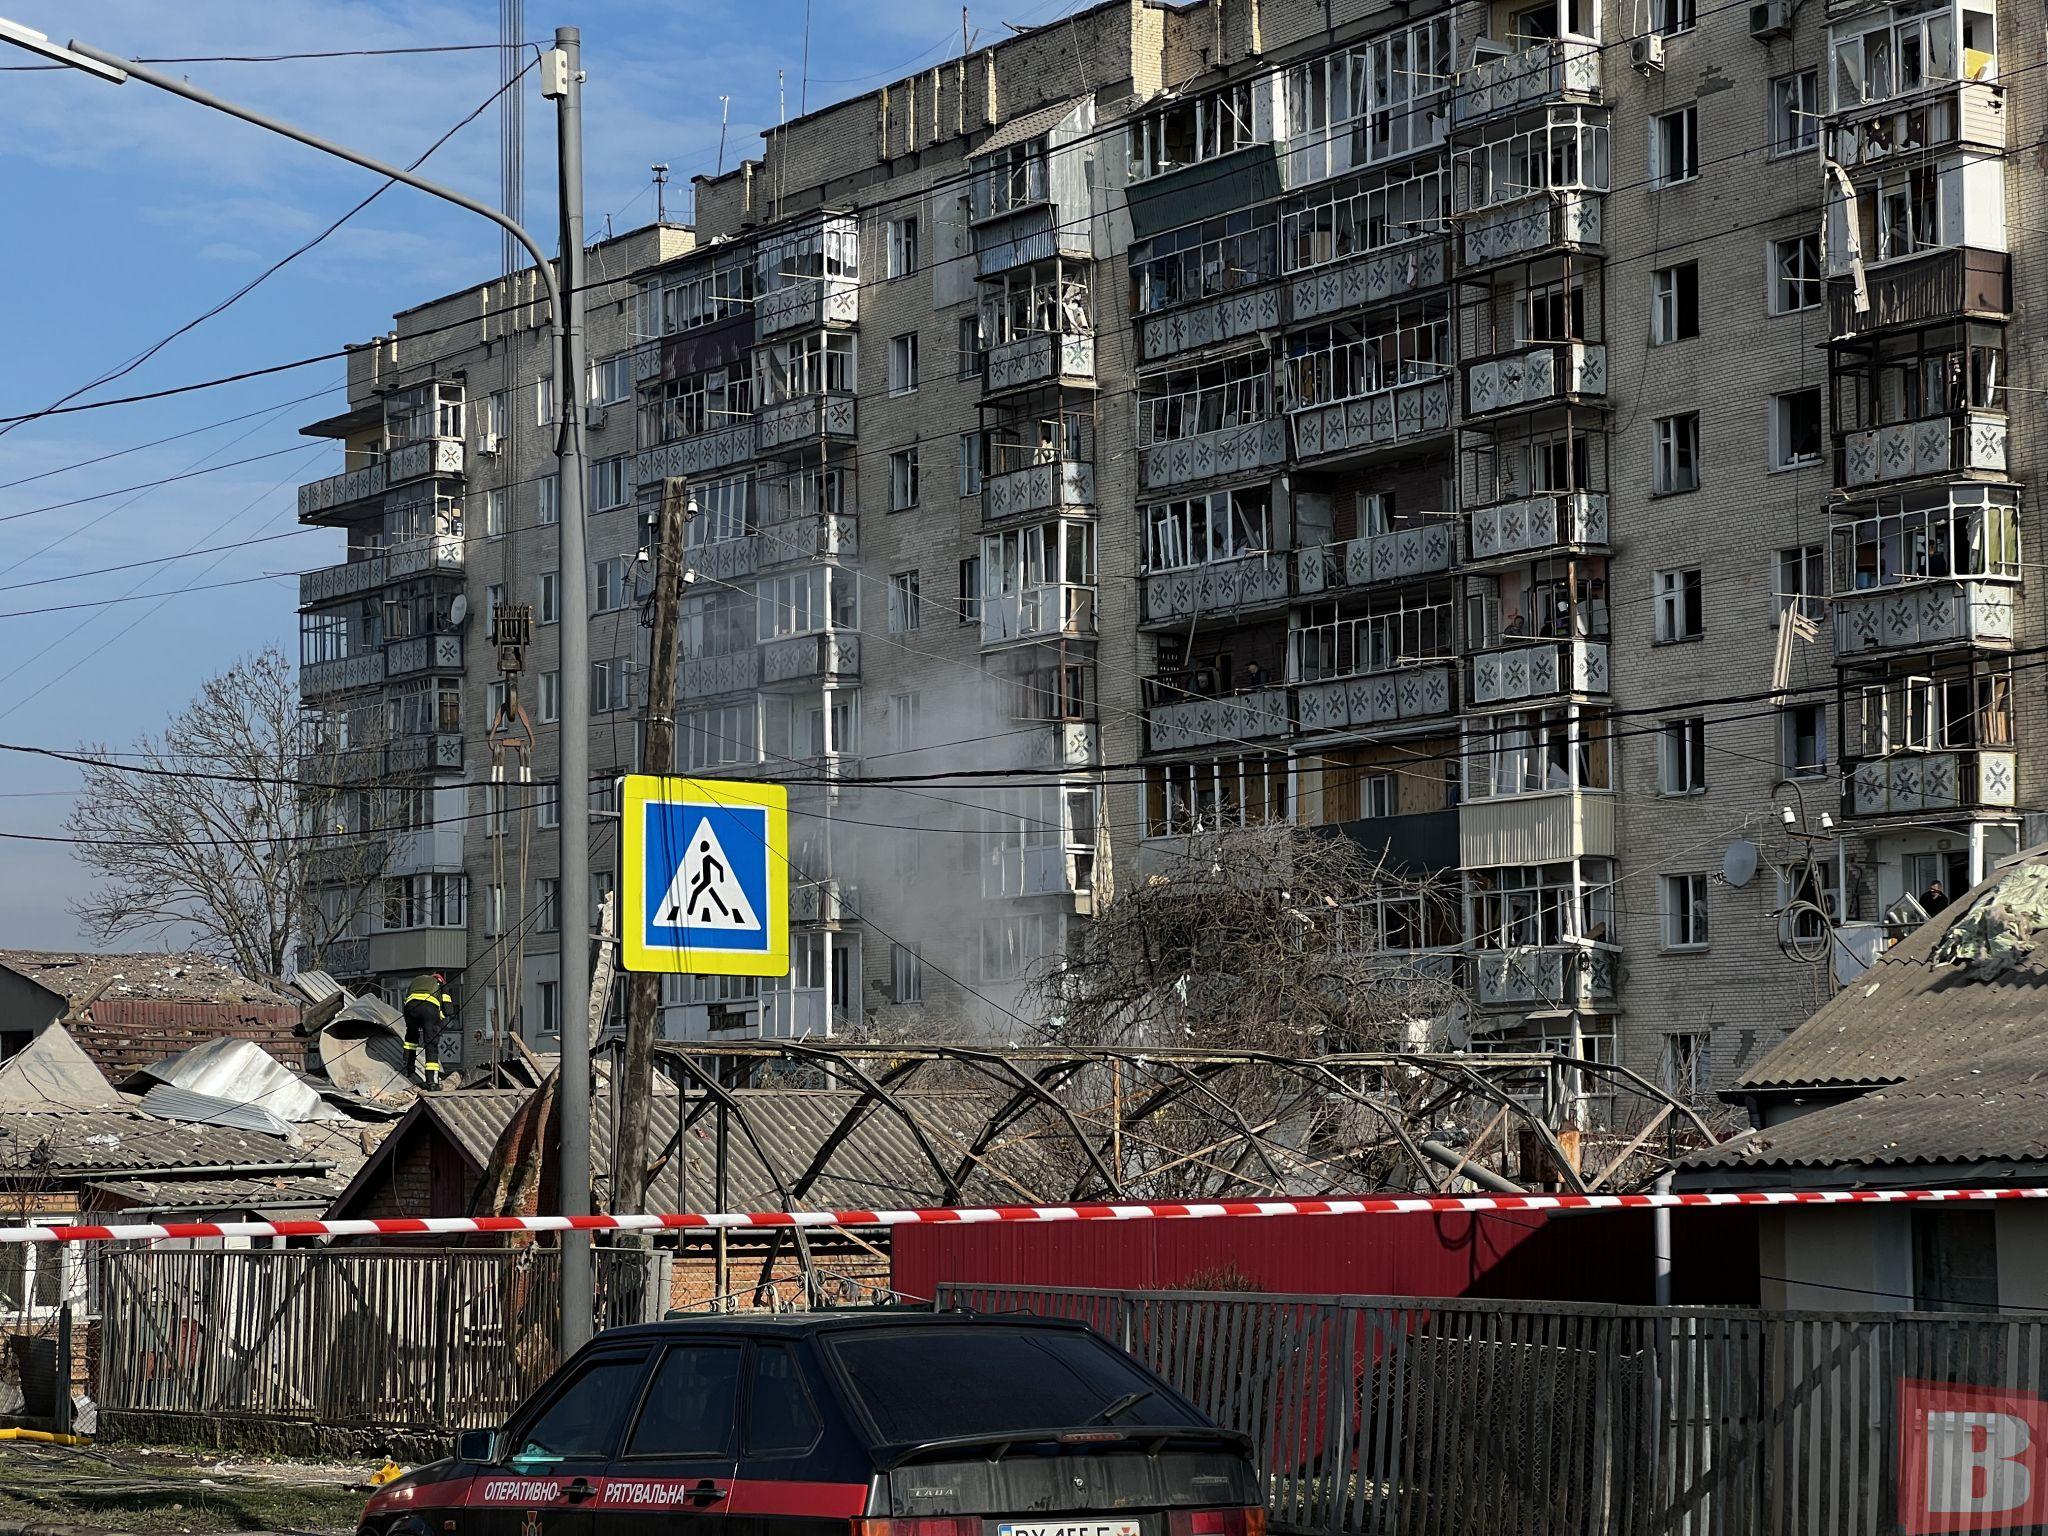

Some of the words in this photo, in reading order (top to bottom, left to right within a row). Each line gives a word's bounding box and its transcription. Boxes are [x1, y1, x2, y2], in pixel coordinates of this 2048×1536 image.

[484, 1482, 561, 1501] ОПЕРАТИВНО-
[604, 1483, 685, 1504] РЯТУВАЛЬНА
[915, 1489, 953, 1497] LADA
